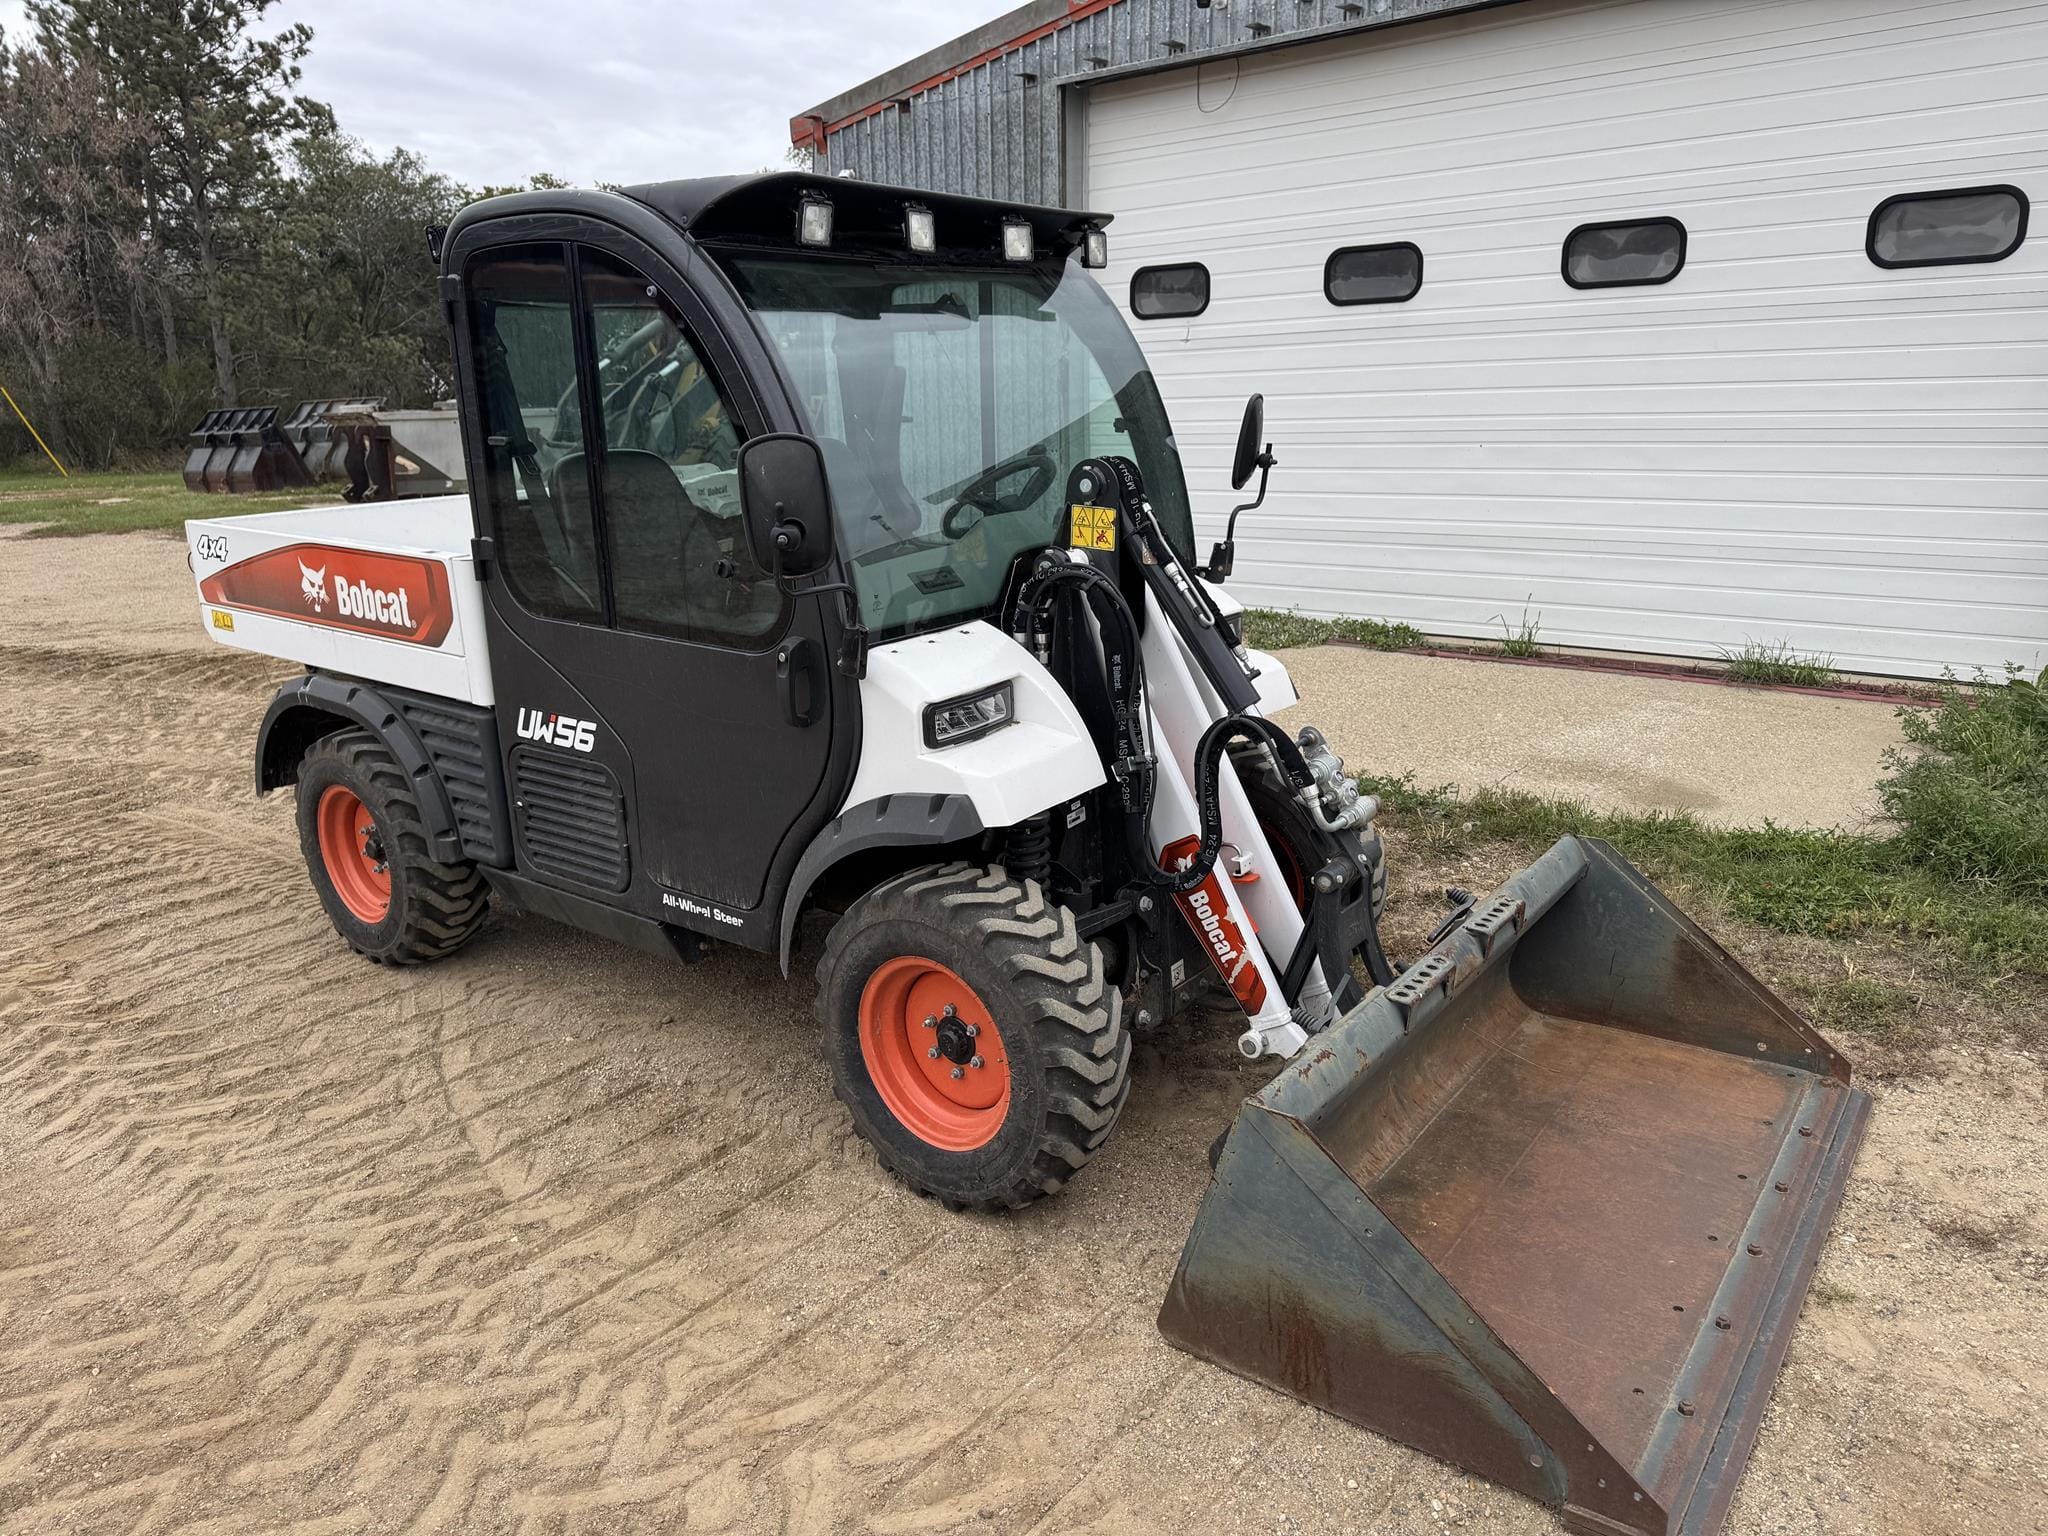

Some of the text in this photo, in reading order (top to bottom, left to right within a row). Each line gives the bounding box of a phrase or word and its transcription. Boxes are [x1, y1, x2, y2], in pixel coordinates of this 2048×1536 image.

[197, 534, 228, 562] 4x4
[334, 575, 412, 629] Bobcat
[1206, 794, 1218, 826] MSHA
[662, 893, 744, 927] All-Wheel Steer
[1188, 889, 1239, 964] Bobcat
